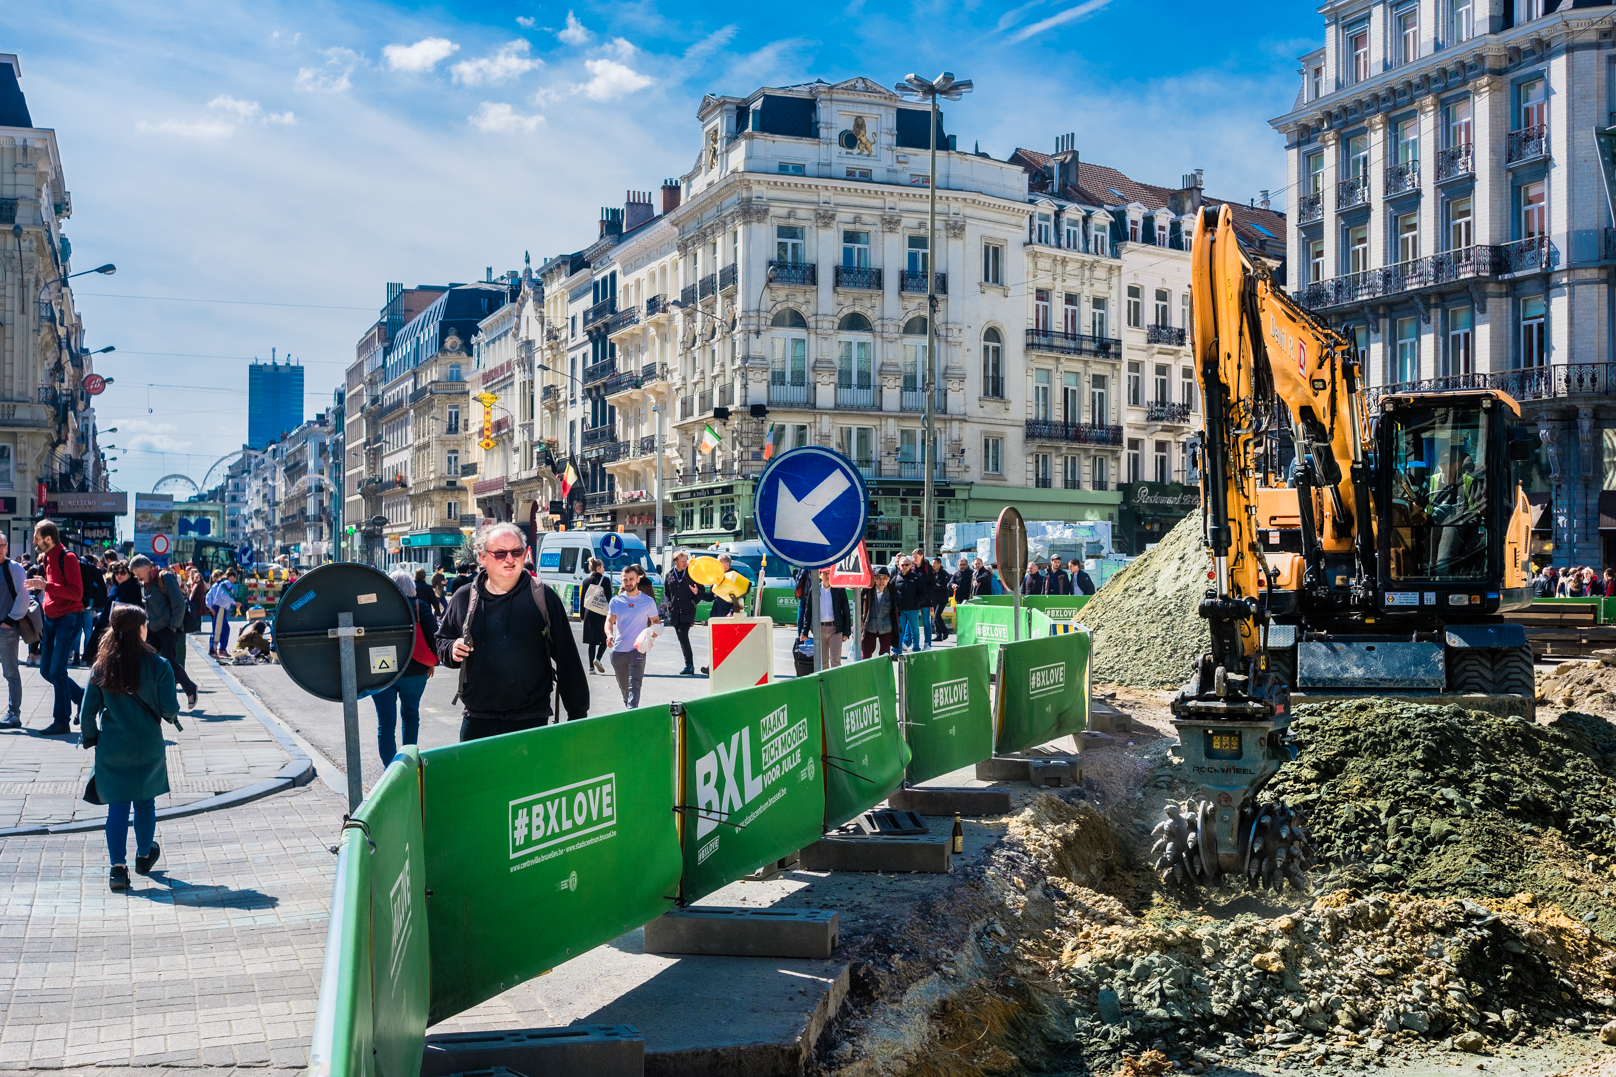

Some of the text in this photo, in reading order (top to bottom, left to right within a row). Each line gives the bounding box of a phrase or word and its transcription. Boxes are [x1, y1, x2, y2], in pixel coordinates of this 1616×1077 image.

[977, 625, 1008, 638] #BXLOVE
[1031, 666, 1064, 689] #BXLOVE
[933, 682, 968, 708] #BXLOVE
[761, 706, 787, 740] MAAKT
[845, 702, 880, 736] #BXLOVE
[762, 737, 780, 769] ZICH
[780, 719, 809, 754] MOOIER
[695, 725, 763, 841] BXL
[763, 764, 781, 788] VOOR
[781, 749, 802, 776] JULLIE
[513, 783, 613, 847] #BXLOVE
